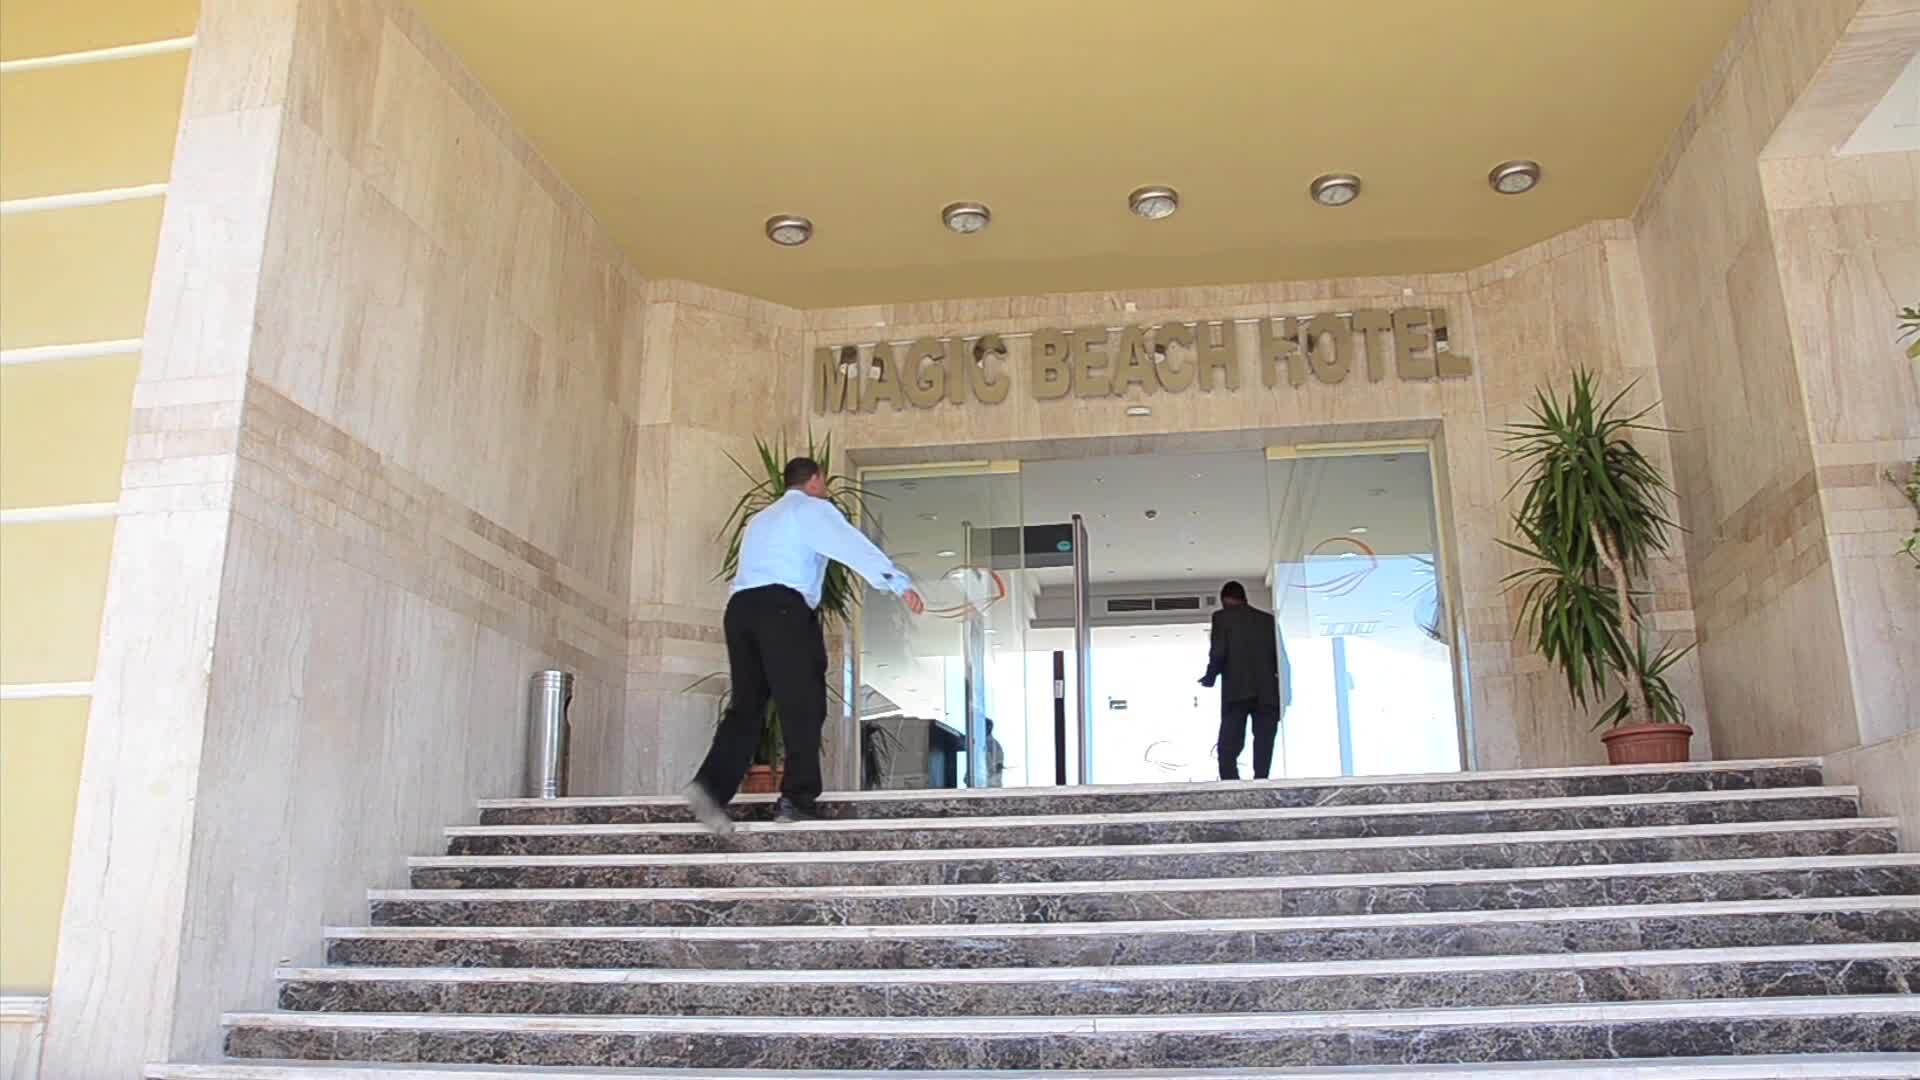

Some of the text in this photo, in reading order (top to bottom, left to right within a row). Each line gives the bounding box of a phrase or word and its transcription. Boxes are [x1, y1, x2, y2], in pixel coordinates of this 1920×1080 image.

[814, 307, 1472, 413] MAGIC BEACH HOTEL
